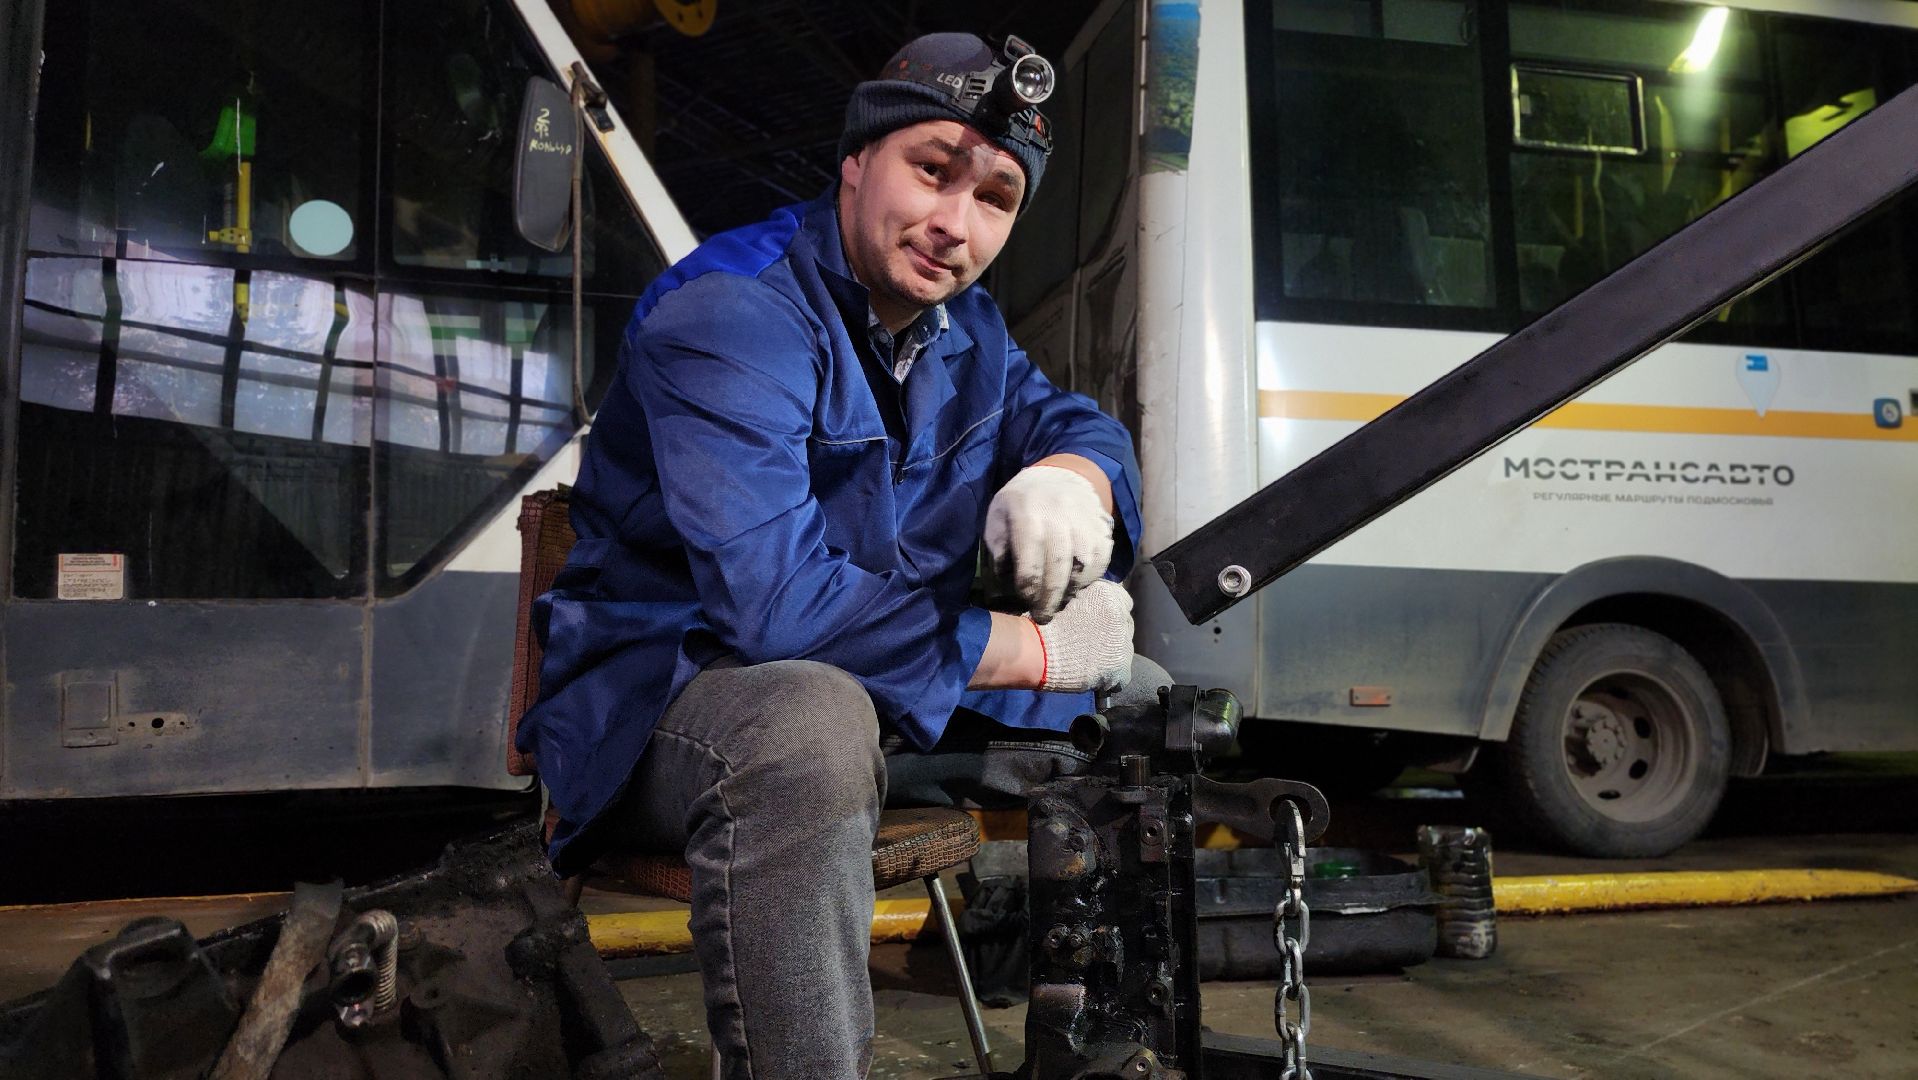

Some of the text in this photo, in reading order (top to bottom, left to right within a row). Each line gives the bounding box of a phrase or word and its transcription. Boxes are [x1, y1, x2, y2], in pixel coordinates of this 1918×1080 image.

[937, 72, 963, 89] LED
[1504, 456, 1795, 486] МОСТРАНСАВТО
[1533, 492, 1774, 506] РЕГУЛЯРНЫЕ МАРШРУТЫ ПОДМОСКОВЬЯ
